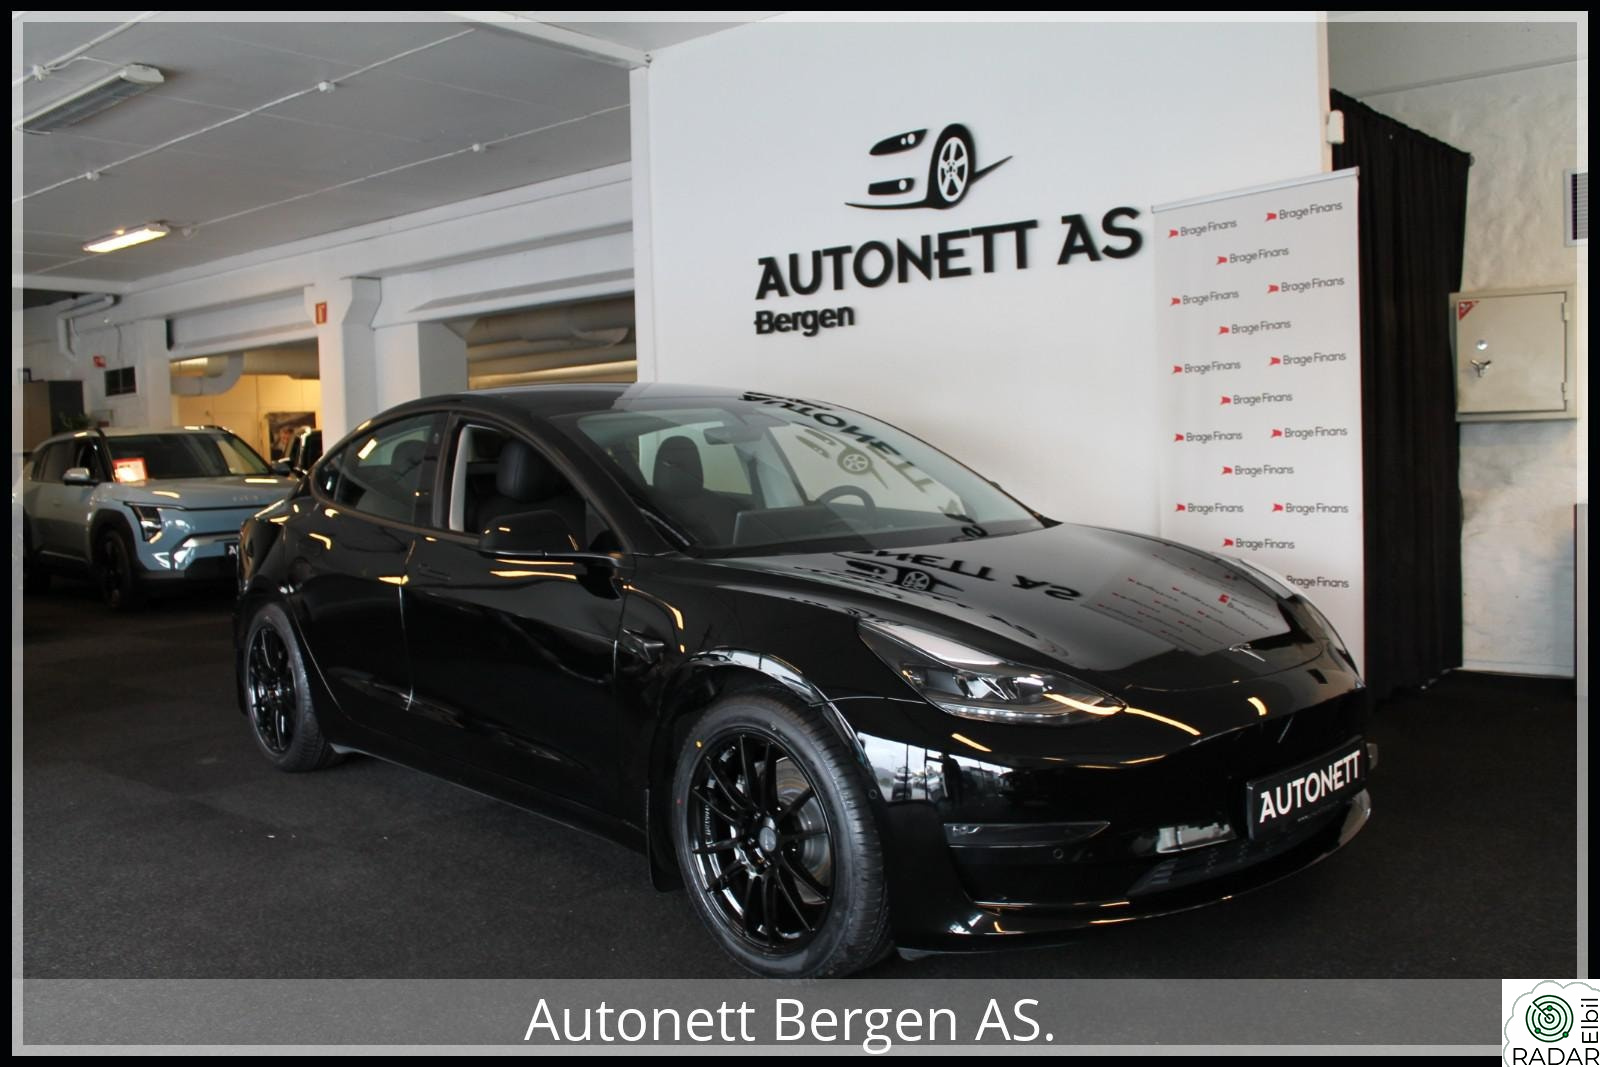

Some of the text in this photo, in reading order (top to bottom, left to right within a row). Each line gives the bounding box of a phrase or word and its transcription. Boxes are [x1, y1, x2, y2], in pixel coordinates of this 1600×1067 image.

[1278, 202, 1343, 221] Brage Finans
[1180, 220, 1238, 237] Brage Finans
[755, 206, 1143, 300] AUTONETT AS
[1229, 247, 1290, 264] Brage Finans
[1280, 277, 1345, 294] Brage Finans
[1182, 291, 1240, 306] Brage Finans
[754, 305, 856, 337] Bergen
[1231, 320, 1292, 336] Brage Finans
[1282, 351, 1347, 367] Brage Finans
[1184, 360, 1241, 375] Brage Finans
[1233, 392, 1293, 407] Brage Finans
[1185, 430, 1243, 445] Brage Finans
[1284, 425, 1348, 441] Brage Finans
[1234, 464, 1295, 478] Brage Finans
[1187, 502, 1244, 516] Brage Finans
[1285, 502, 1349, 516] Brage Finans
[1235, 537, 1296, 552] Brage Finans
[1286, 575, 1350, 589] Brage Finans
[1259, 750, 1361, 824] AUTONETT
